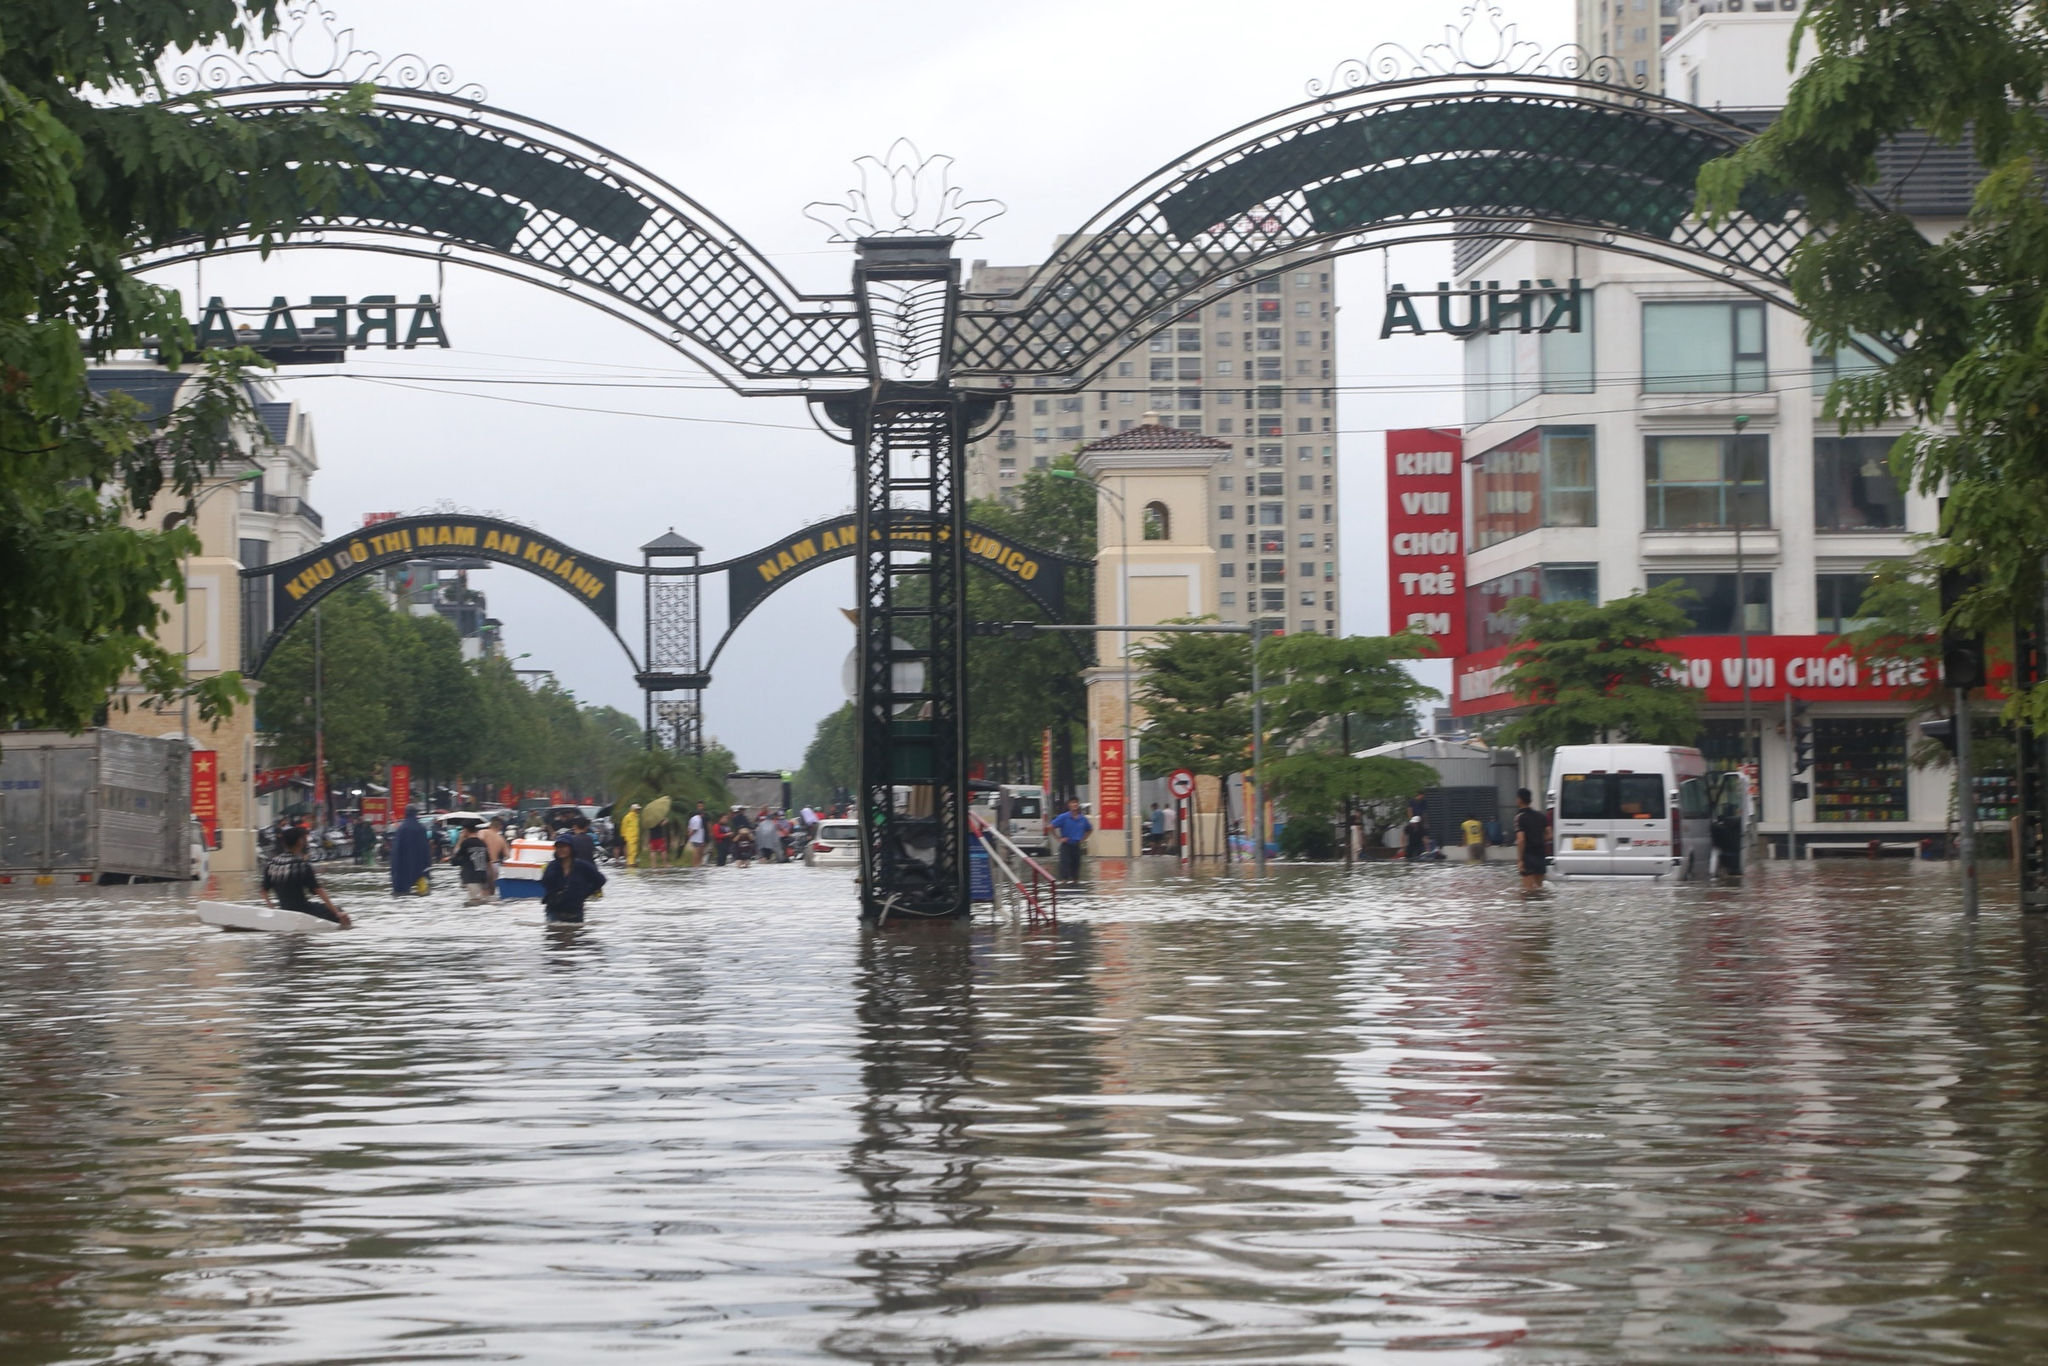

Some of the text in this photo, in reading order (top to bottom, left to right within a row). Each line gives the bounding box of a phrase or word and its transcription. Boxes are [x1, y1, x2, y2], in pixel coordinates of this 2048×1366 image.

[1395, 451, 1453, 476] KHU
[1400, 491, 1450, 515] VUI
[757, 538, 818, 582] NAM
[822, 525, 857, 552] AN
[1392, 528, 1459, 556] CHƠI
[285, 557, 336, 600] KHU
[416, 526, 477, 547] NAM
[483, 530, 521, 555] AN
[523, 541, 605, 599] KHÁNH
[1398, 565, 1456, 596] TRẺ
[1407, 612, 1450, 636] EM
[1722, 657, 1775, 688] VUI
[1785, 653, 1859, 688] CHƠI
